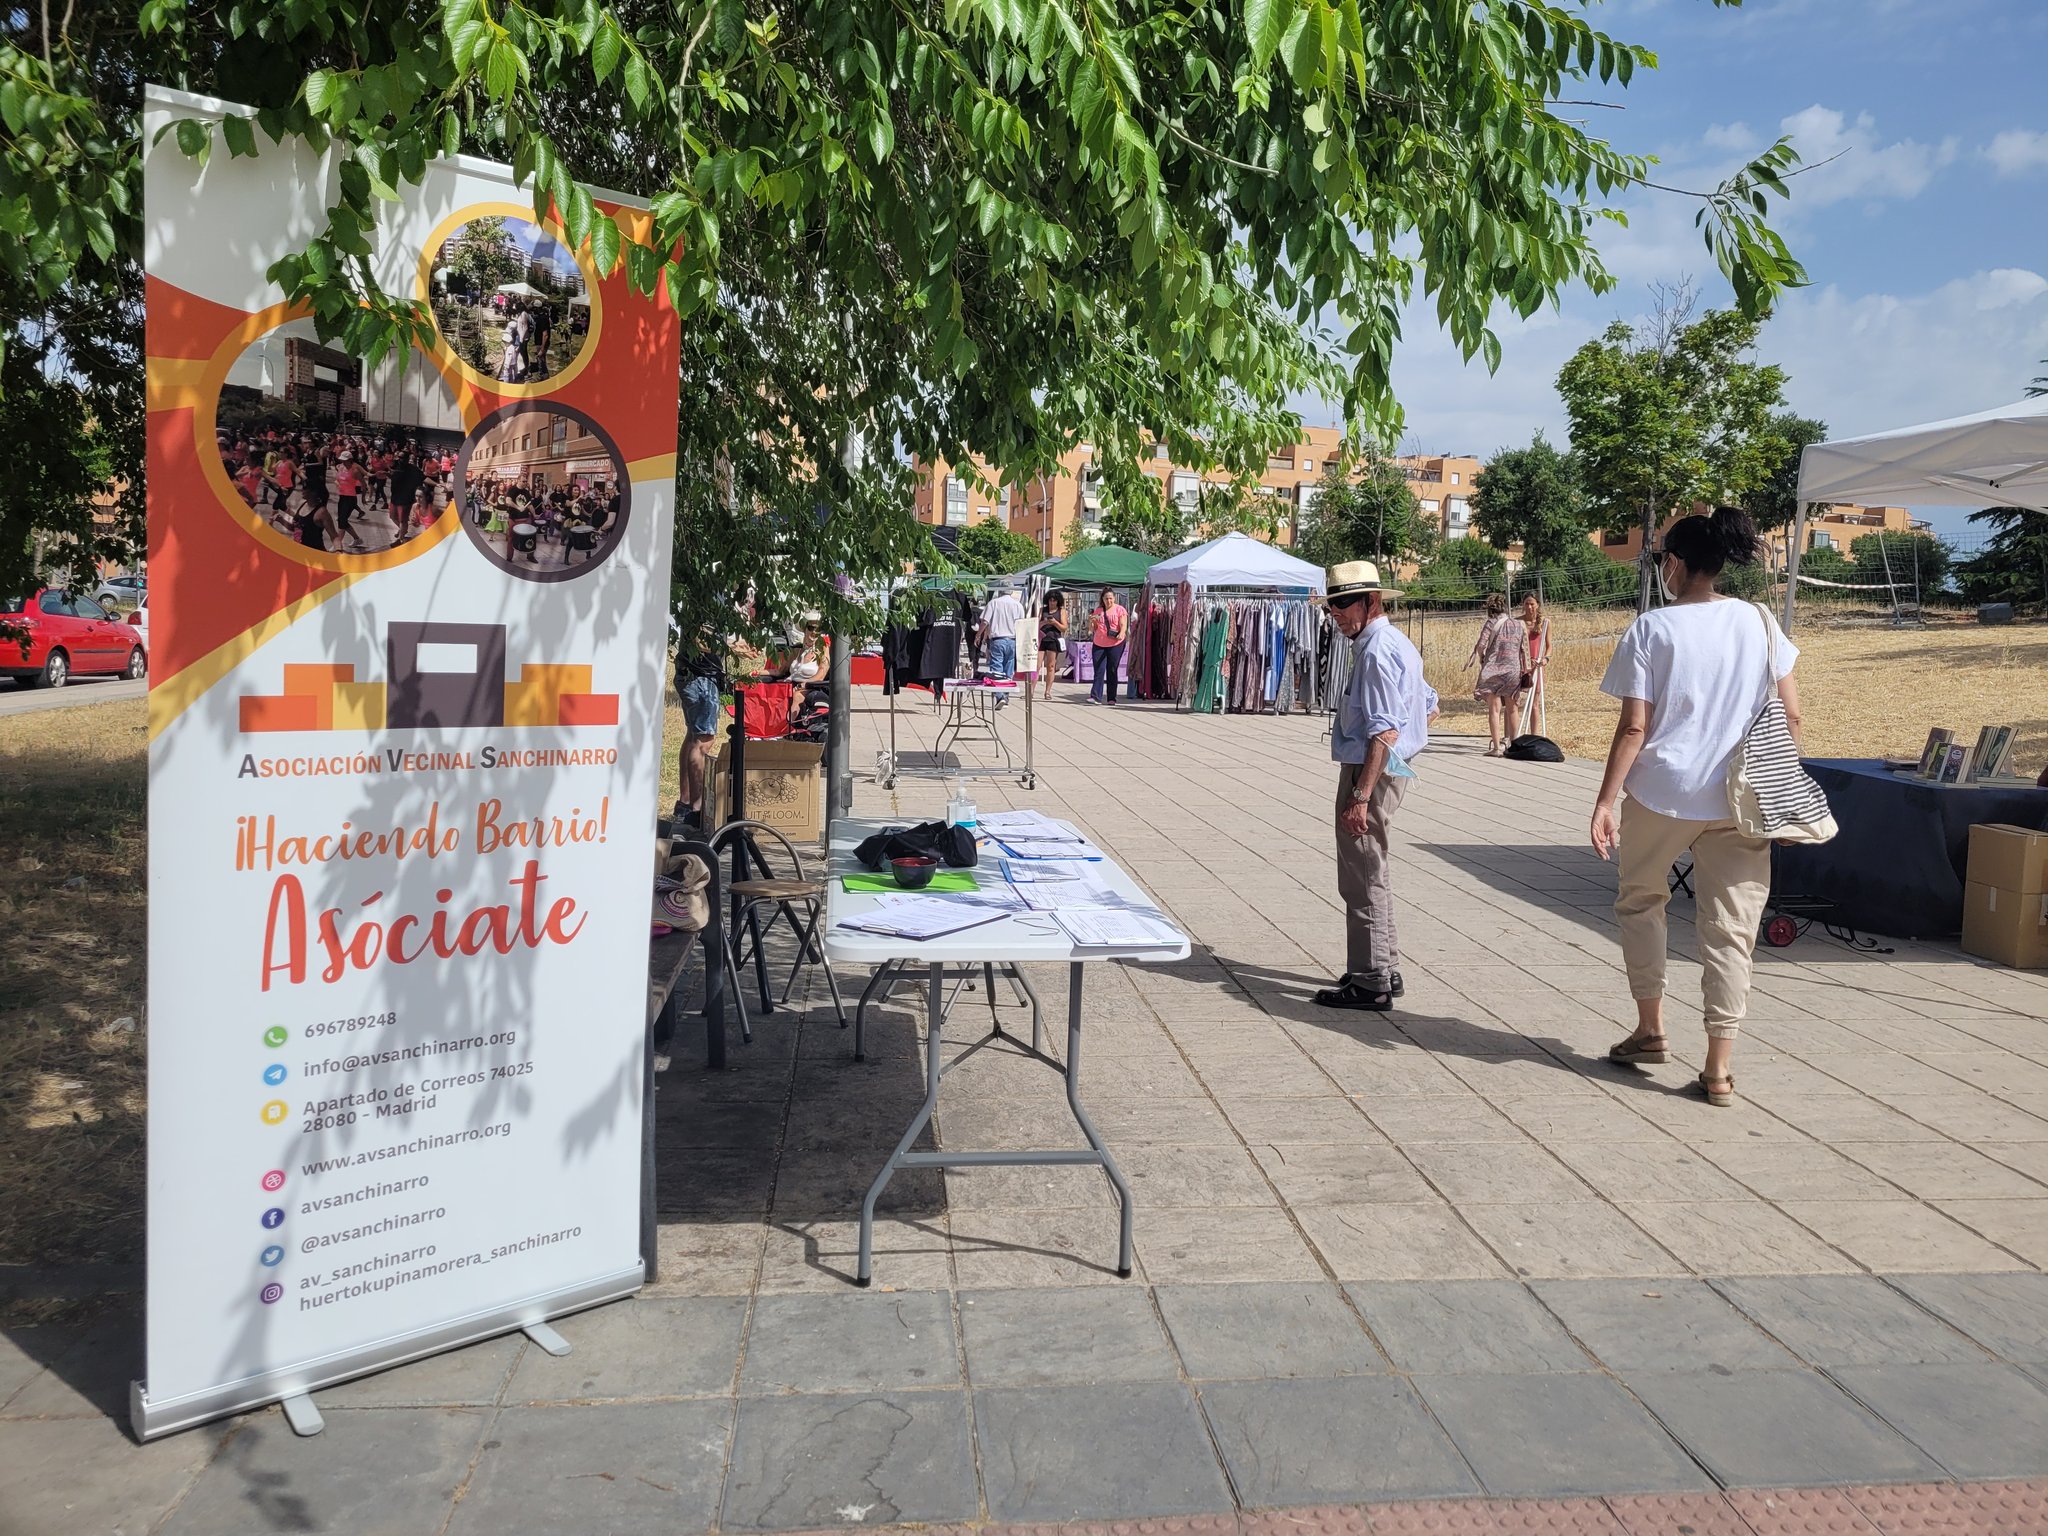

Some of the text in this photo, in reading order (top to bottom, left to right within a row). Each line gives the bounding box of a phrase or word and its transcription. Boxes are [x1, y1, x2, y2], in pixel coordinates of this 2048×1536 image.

[238, 746, 618, 778] ASOCIACIÓN VECINAL SANCHINARRO
[476, 796, 609, 854] Barrio!
[262, 860, 588, 992] Asóciate
[304, 1012, 397, 1038] 696789248
[304, 1031, 516, 1077] info@avsanchinarro.org
[302, 1061, 534, 1116] Apartado de Correos 74025
[302, 1111, 357, 1133] 28080
[376, 1094, 437, 1119] Madrid
[301, 1122, 512, 1176] www.avsanchinarro.org
[301, 1174, 429, 1214] avsanchinarro
[301, 1206, 446, 1254] @avsanchinarro
[300, 1243, 437, 1289] av_sanchinarro
[300, 1225, 582, 1311] huertokupinamorera_sanchinarro
